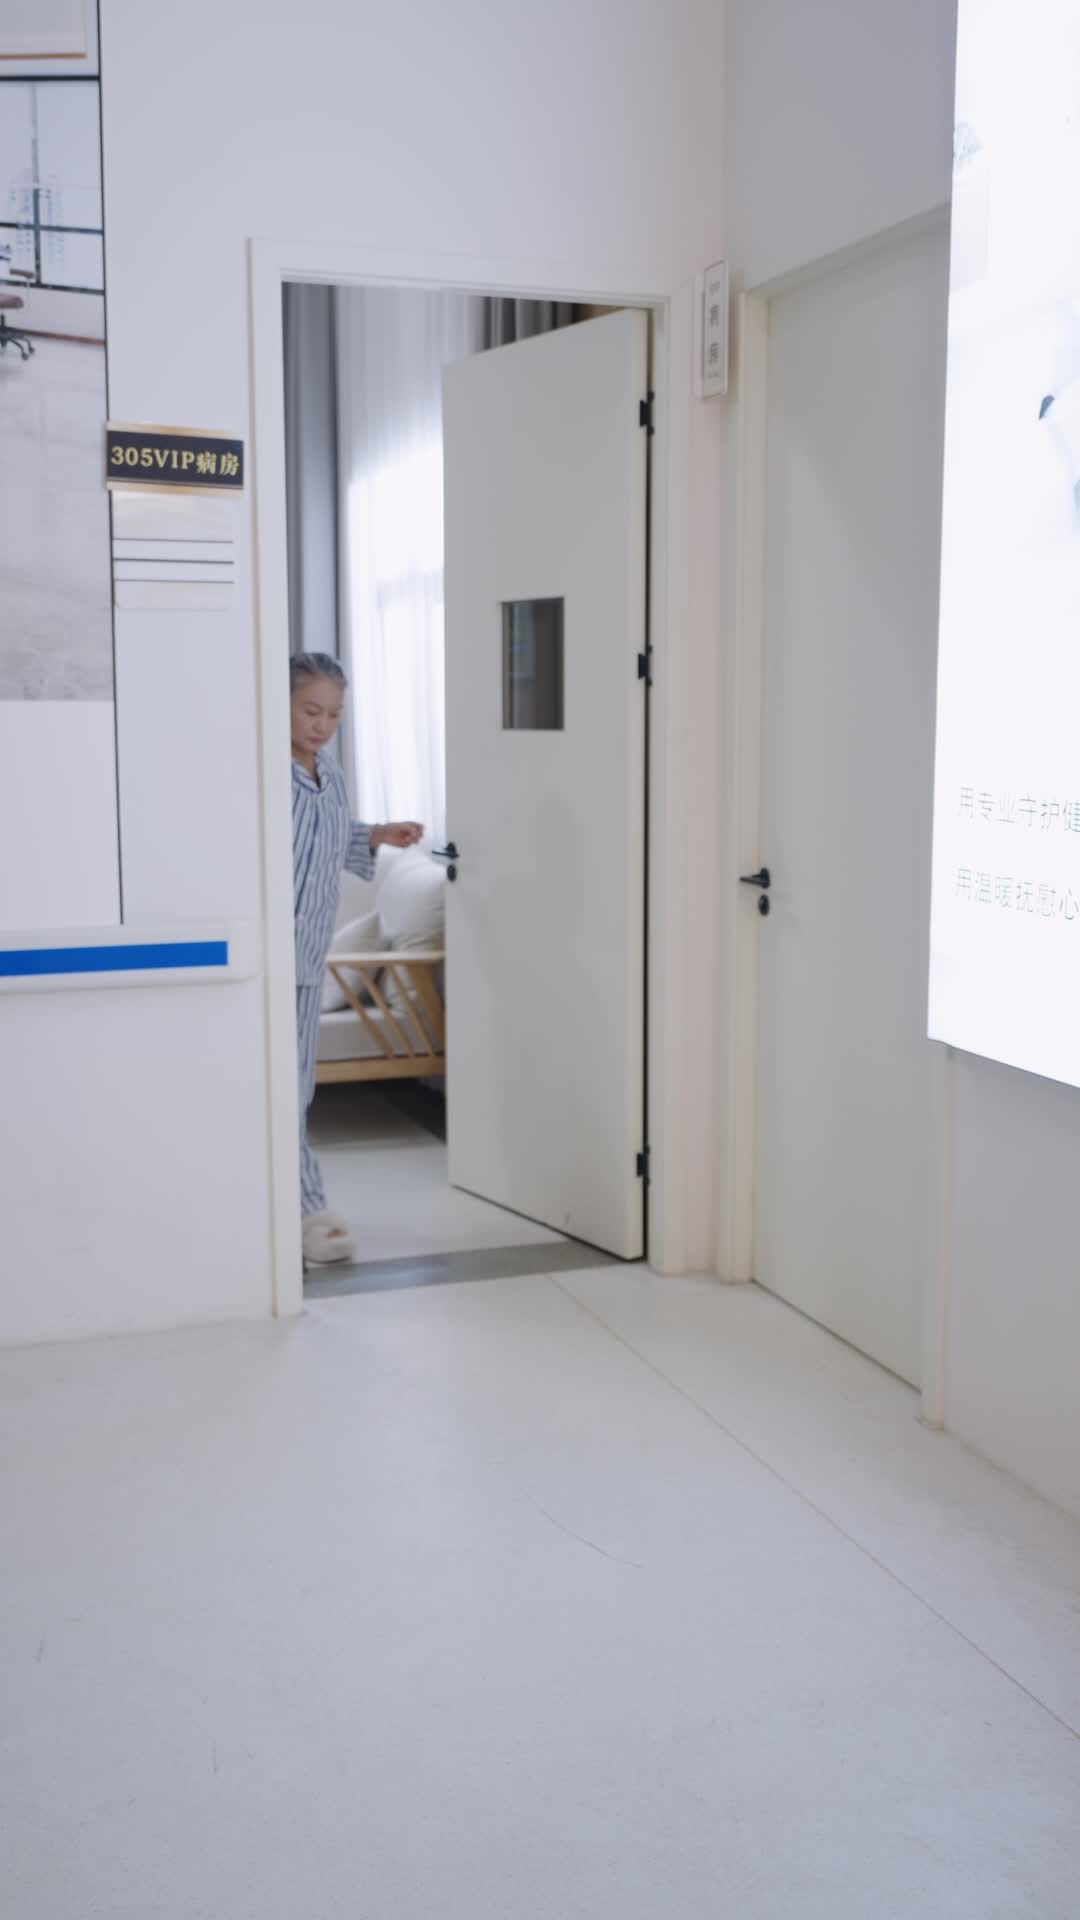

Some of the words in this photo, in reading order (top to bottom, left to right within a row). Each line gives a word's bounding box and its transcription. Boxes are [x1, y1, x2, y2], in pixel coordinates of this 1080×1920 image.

[111, 446, 239, 476] 305VIP病房
[956, 867, 1079, 920] 用温暖抚慰心
